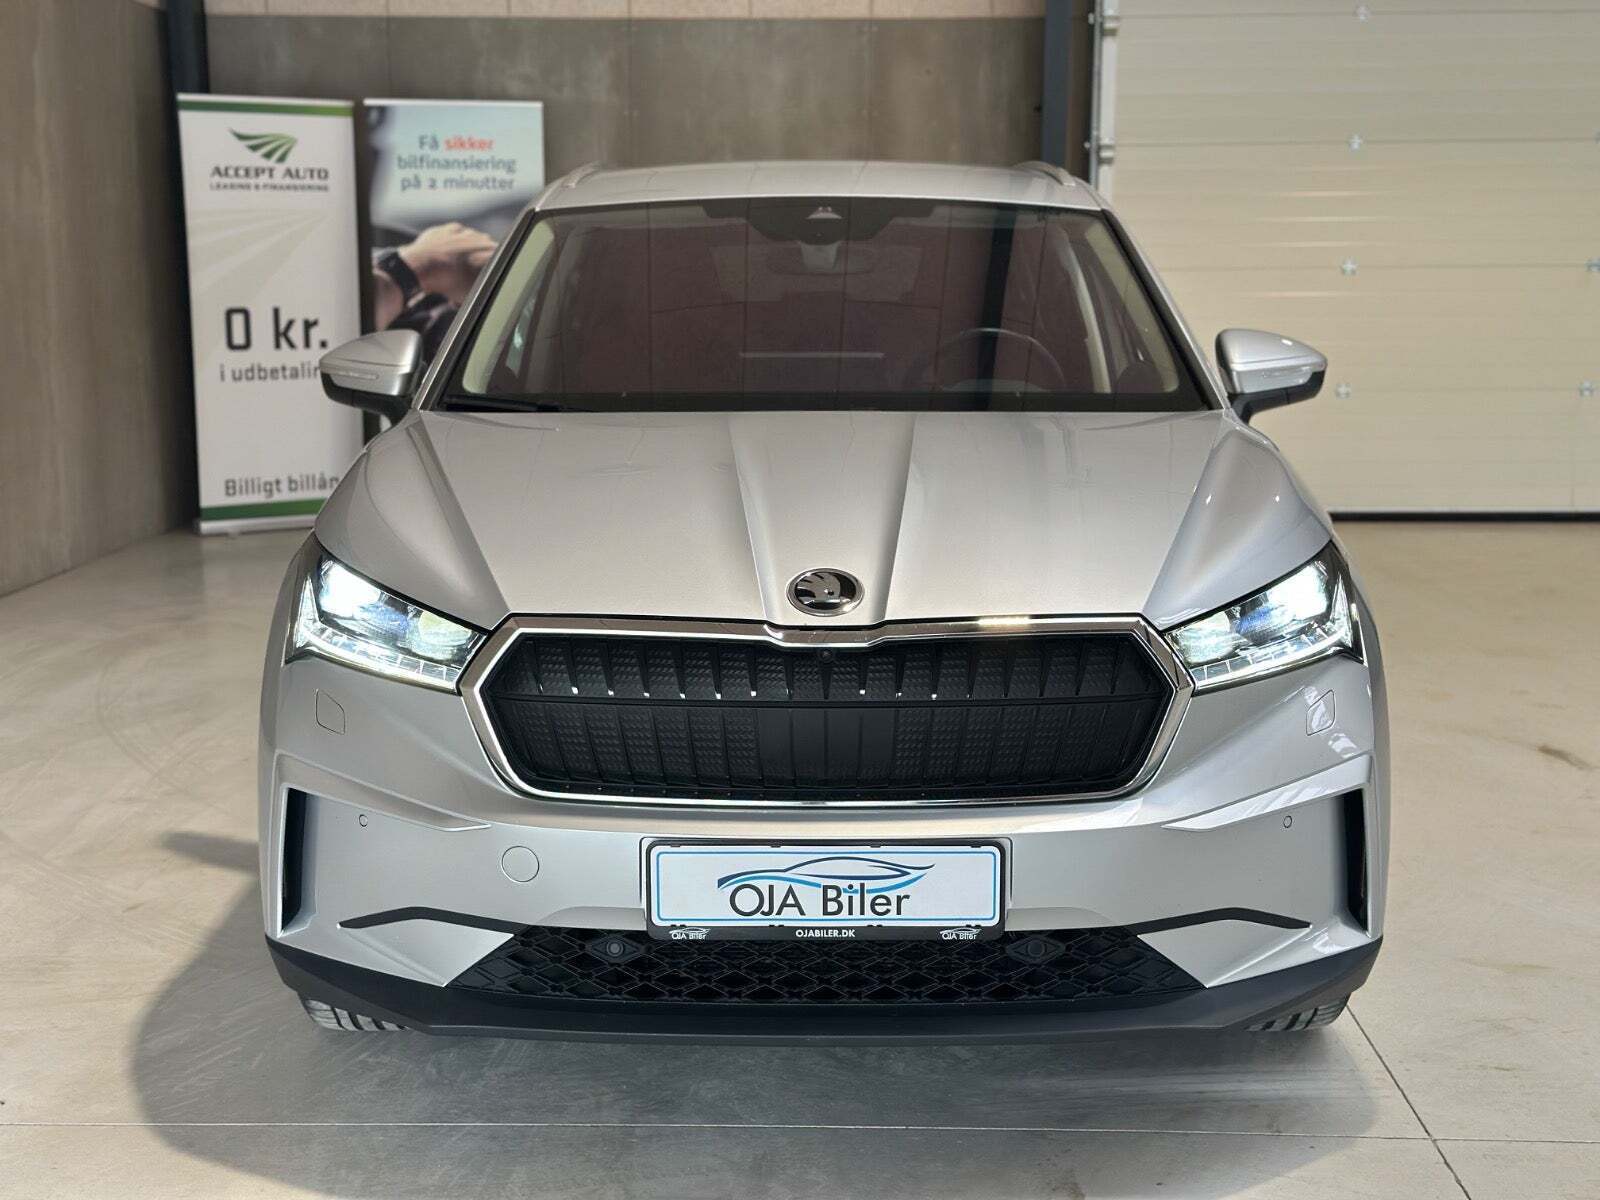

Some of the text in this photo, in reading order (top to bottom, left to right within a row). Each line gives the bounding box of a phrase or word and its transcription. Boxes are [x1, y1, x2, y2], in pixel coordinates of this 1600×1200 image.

[418, 135, 494, 150] Få sikker
[211, 166, 329, 180] ACCEPT AUTO
[398, 155, 516, 173] bilfinansiering
[401, 175, 514, 191] på 2 minutter
[273, 307, 327, 349] kr.
[221, 362, 320, 381] i udbetalin
[224, 478, 281, 498] Billigt
[729, 883, 911, 917] OJA Biler
[795, 929, 856, 938] OJABILER.DK
